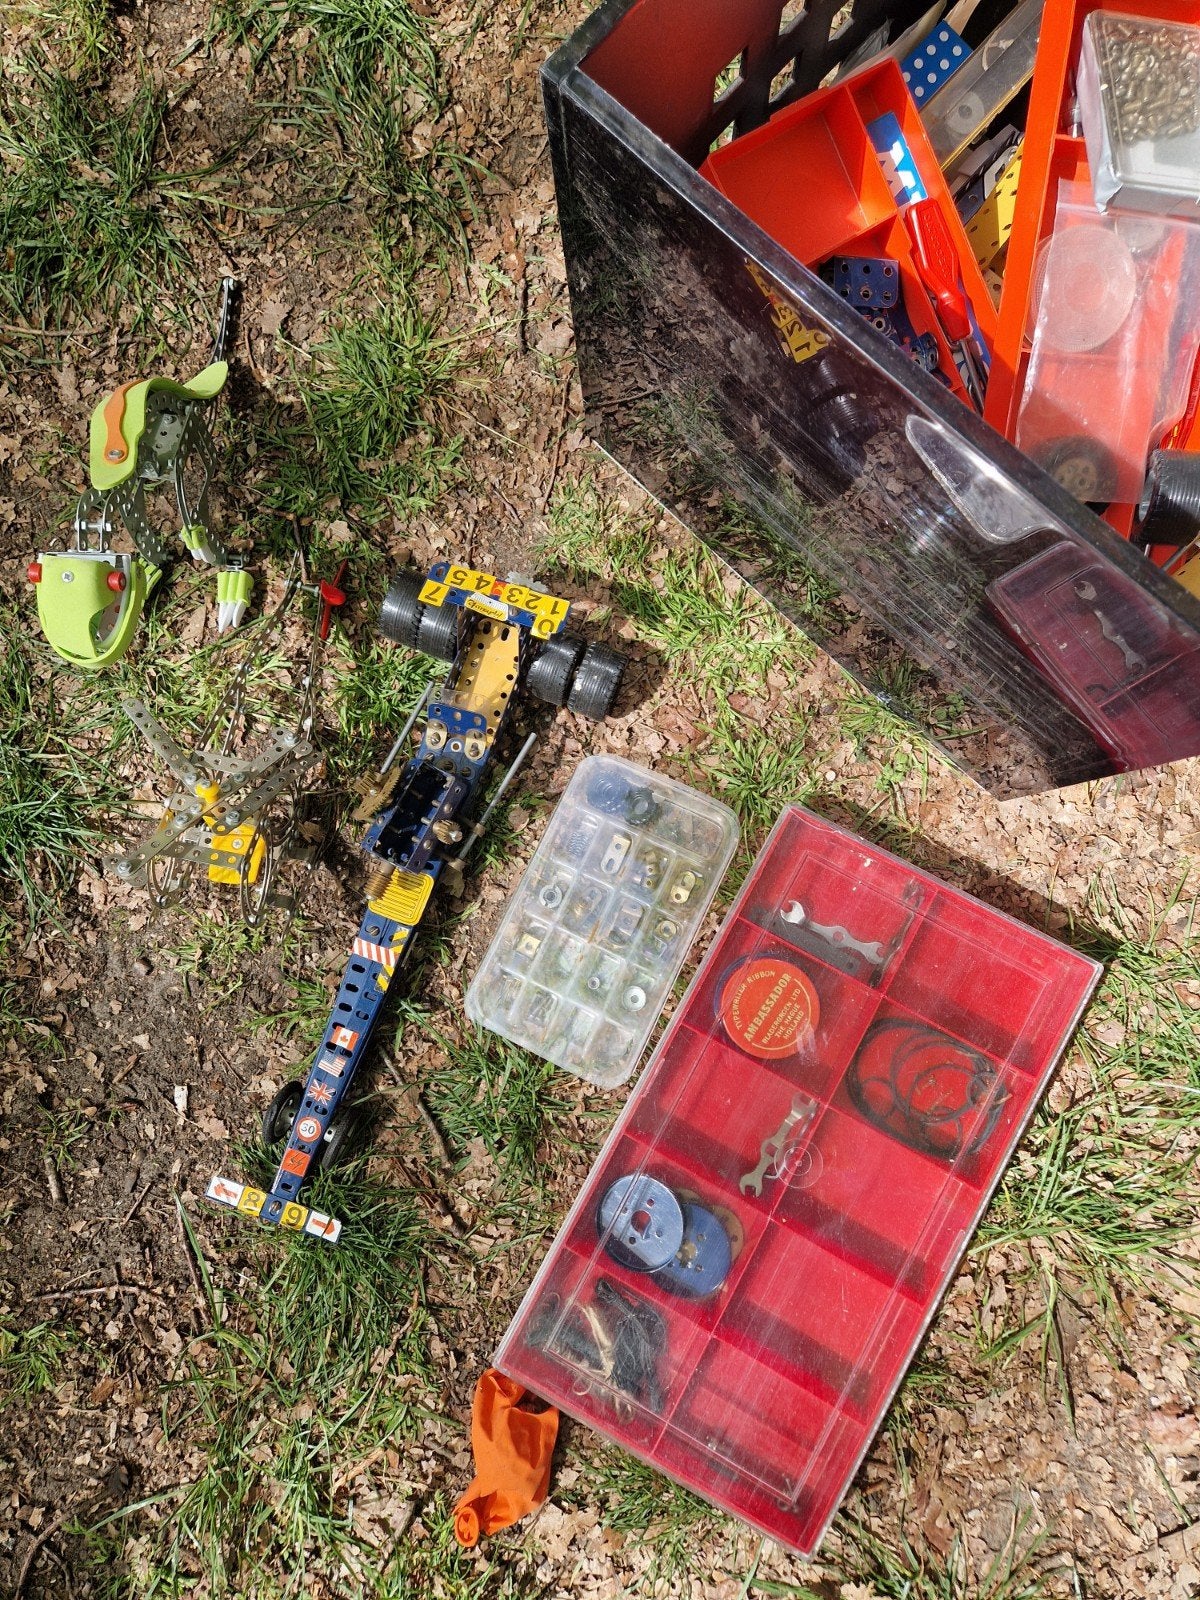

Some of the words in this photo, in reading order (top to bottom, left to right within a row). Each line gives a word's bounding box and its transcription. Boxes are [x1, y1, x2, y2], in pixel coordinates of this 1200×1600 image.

[732, 984, 747, 1030] TYPEWRITER
[747, 970, 776, 983] RIBBON
[743, 973, 791, 1041] AMBASSADOR
[791, 988, 801, 1001] LTD
[774, 1025, 787, 1038] THE
[785, 1003, 801, 1025] HAGUE
[783, 1010, 804, 1039] HOLLAND
[300, 1122, 315, 1135] 30
